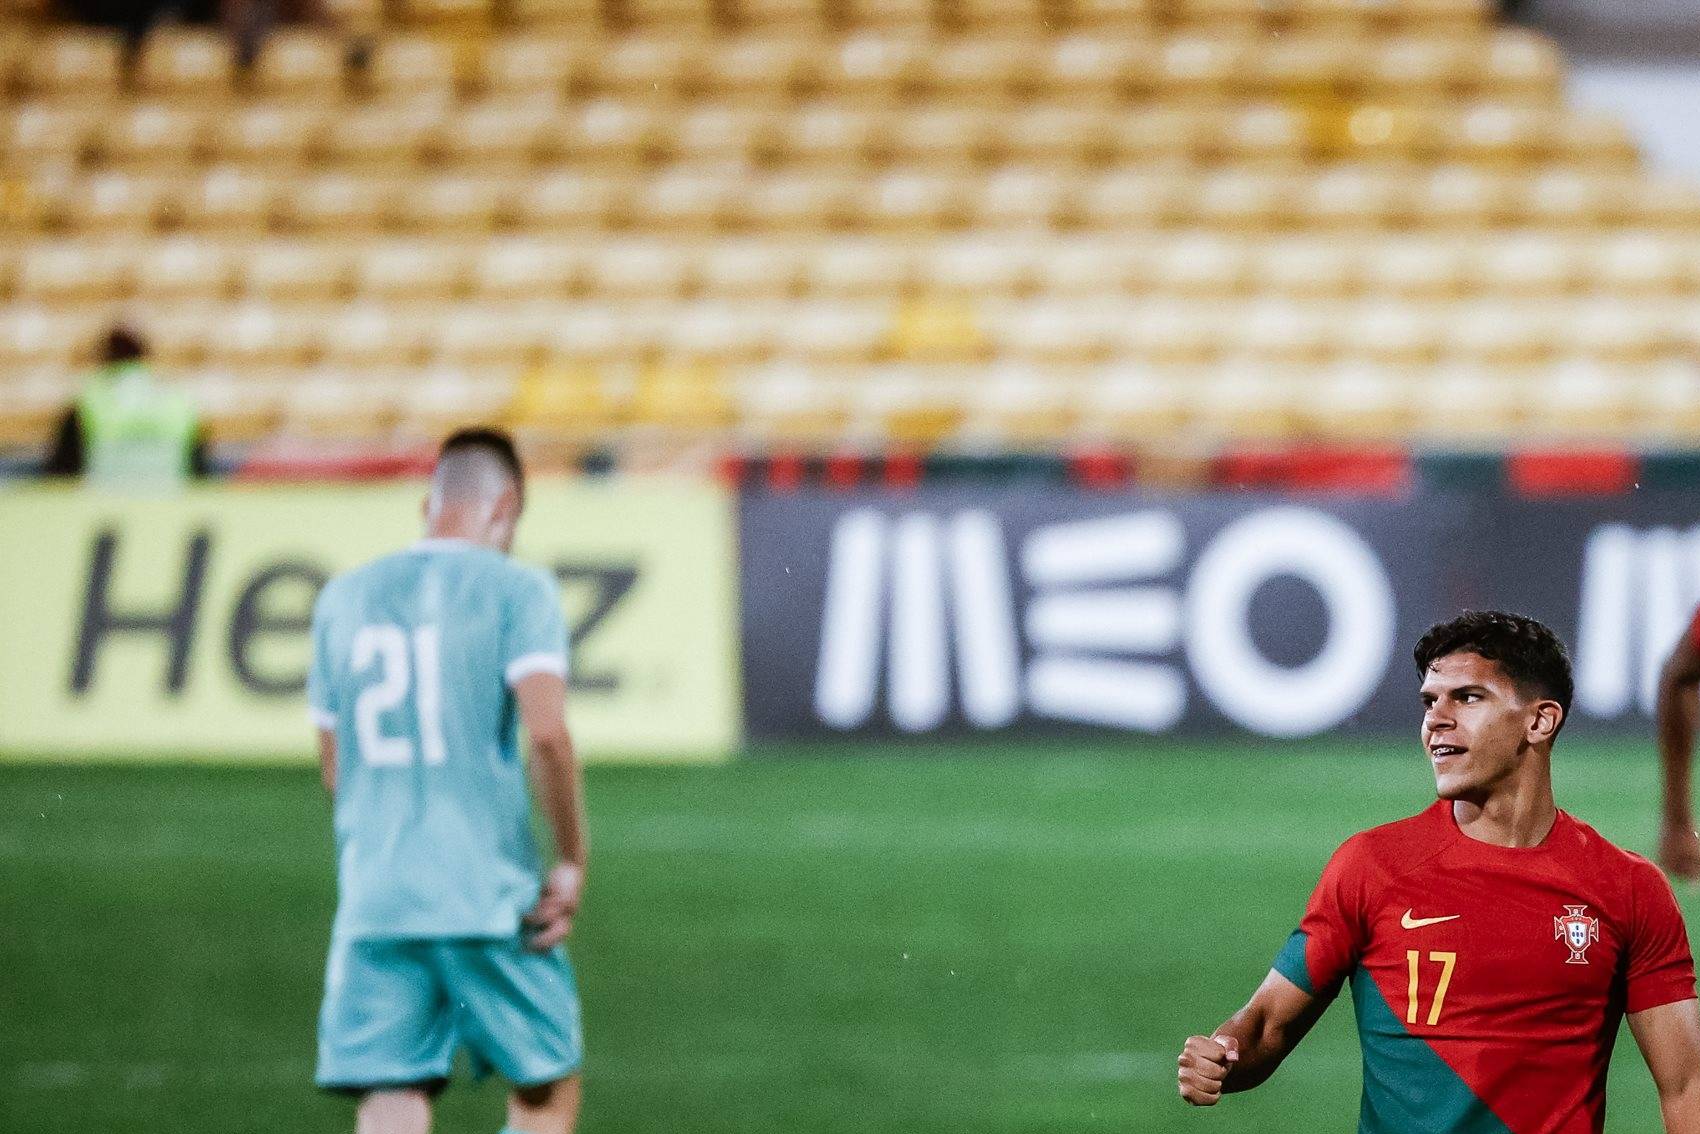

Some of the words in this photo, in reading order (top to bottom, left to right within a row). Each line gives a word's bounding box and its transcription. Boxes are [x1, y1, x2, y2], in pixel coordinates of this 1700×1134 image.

[70, 518, 645, 697] Hez
[812, 505, 1398, 738] MEO
[352, 619, 449, 768] 21
[1406, 949, 1457, 1026] 17
